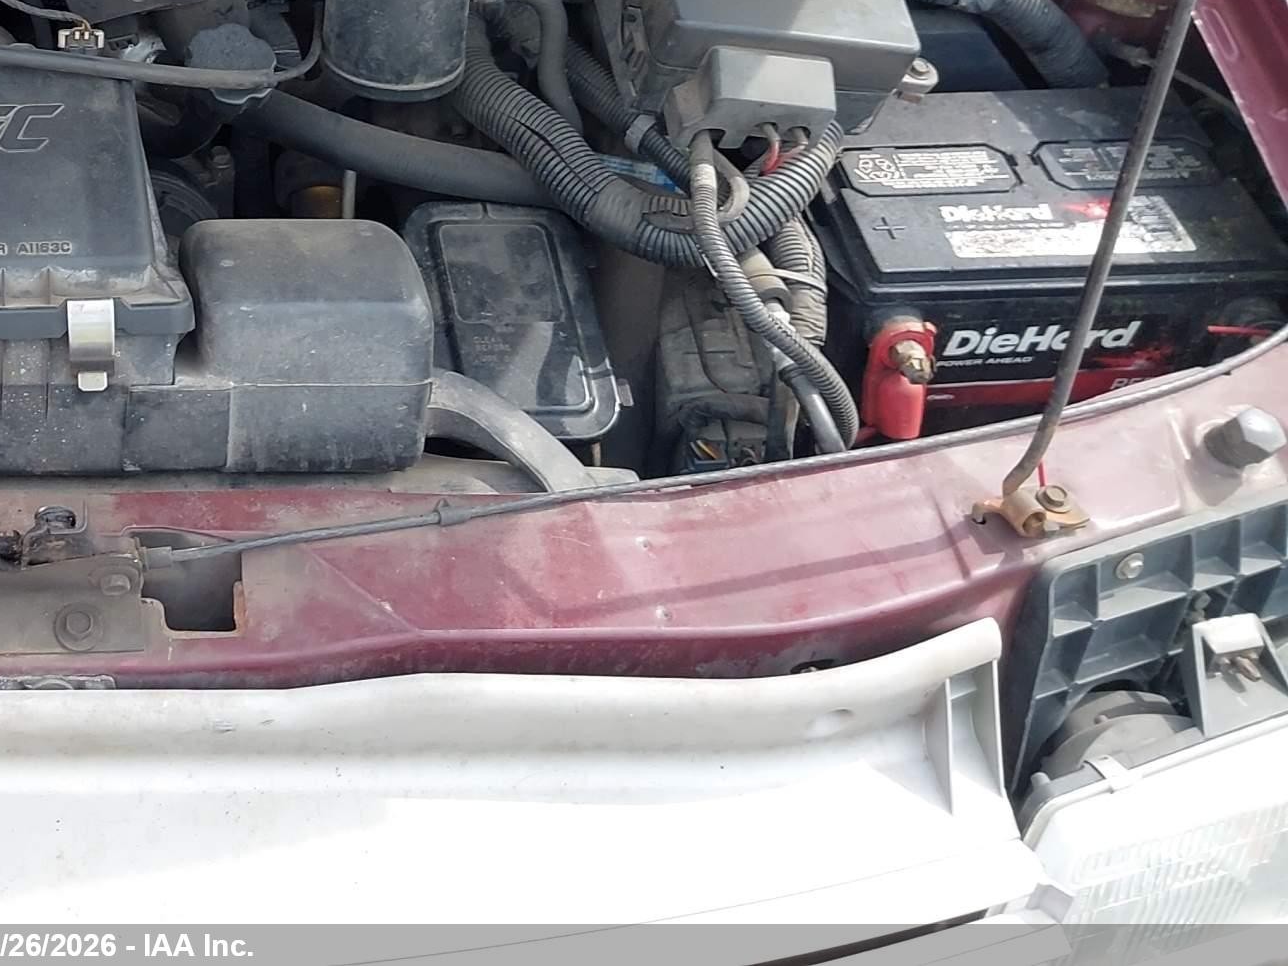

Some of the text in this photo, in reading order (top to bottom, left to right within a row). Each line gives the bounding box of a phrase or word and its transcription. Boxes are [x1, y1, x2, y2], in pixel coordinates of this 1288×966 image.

[938, 203, 1054, 223] DieHard
[935, 356, 1034, 367] POWER AHEAD
